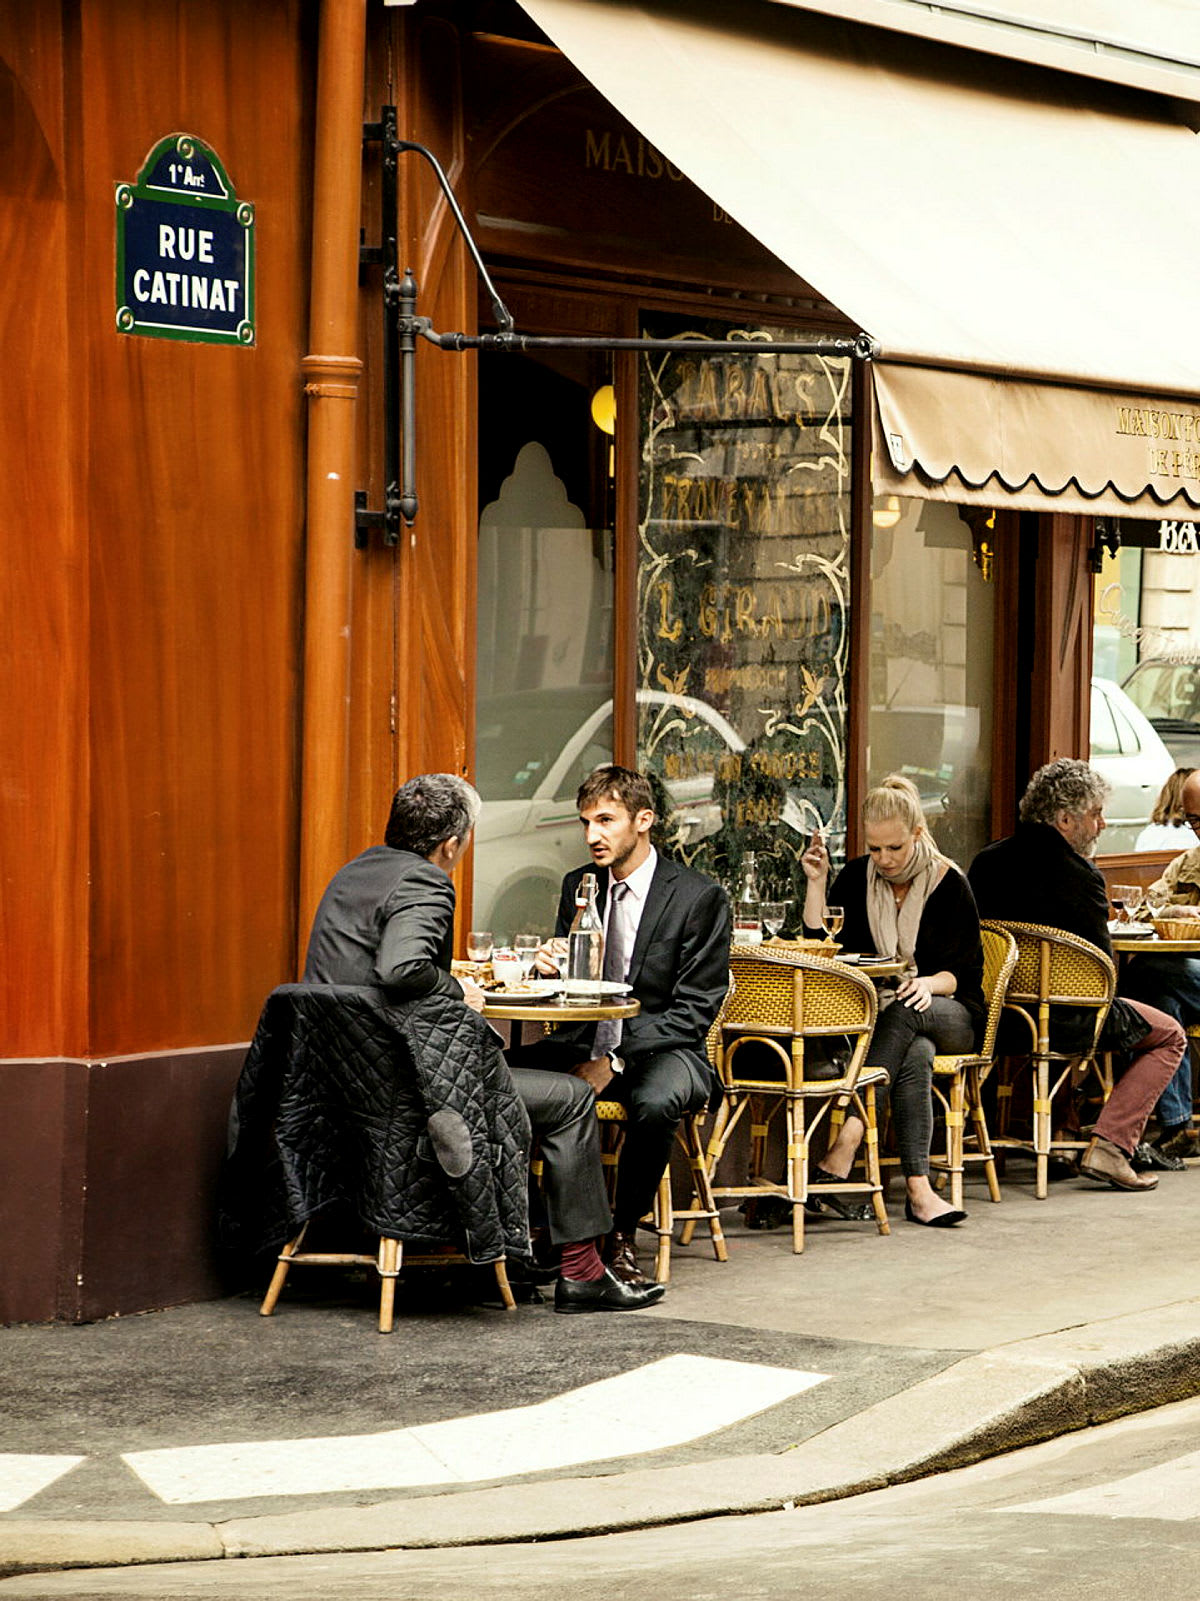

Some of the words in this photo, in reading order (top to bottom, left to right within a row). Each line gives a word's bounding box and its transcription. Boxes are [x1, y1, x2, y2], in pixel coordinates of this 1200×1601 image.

[158, 224, 215, 264] RUE
[133, 268, 240, 313] CATINAT
[1115, 407, 1182, 440] MAISON
